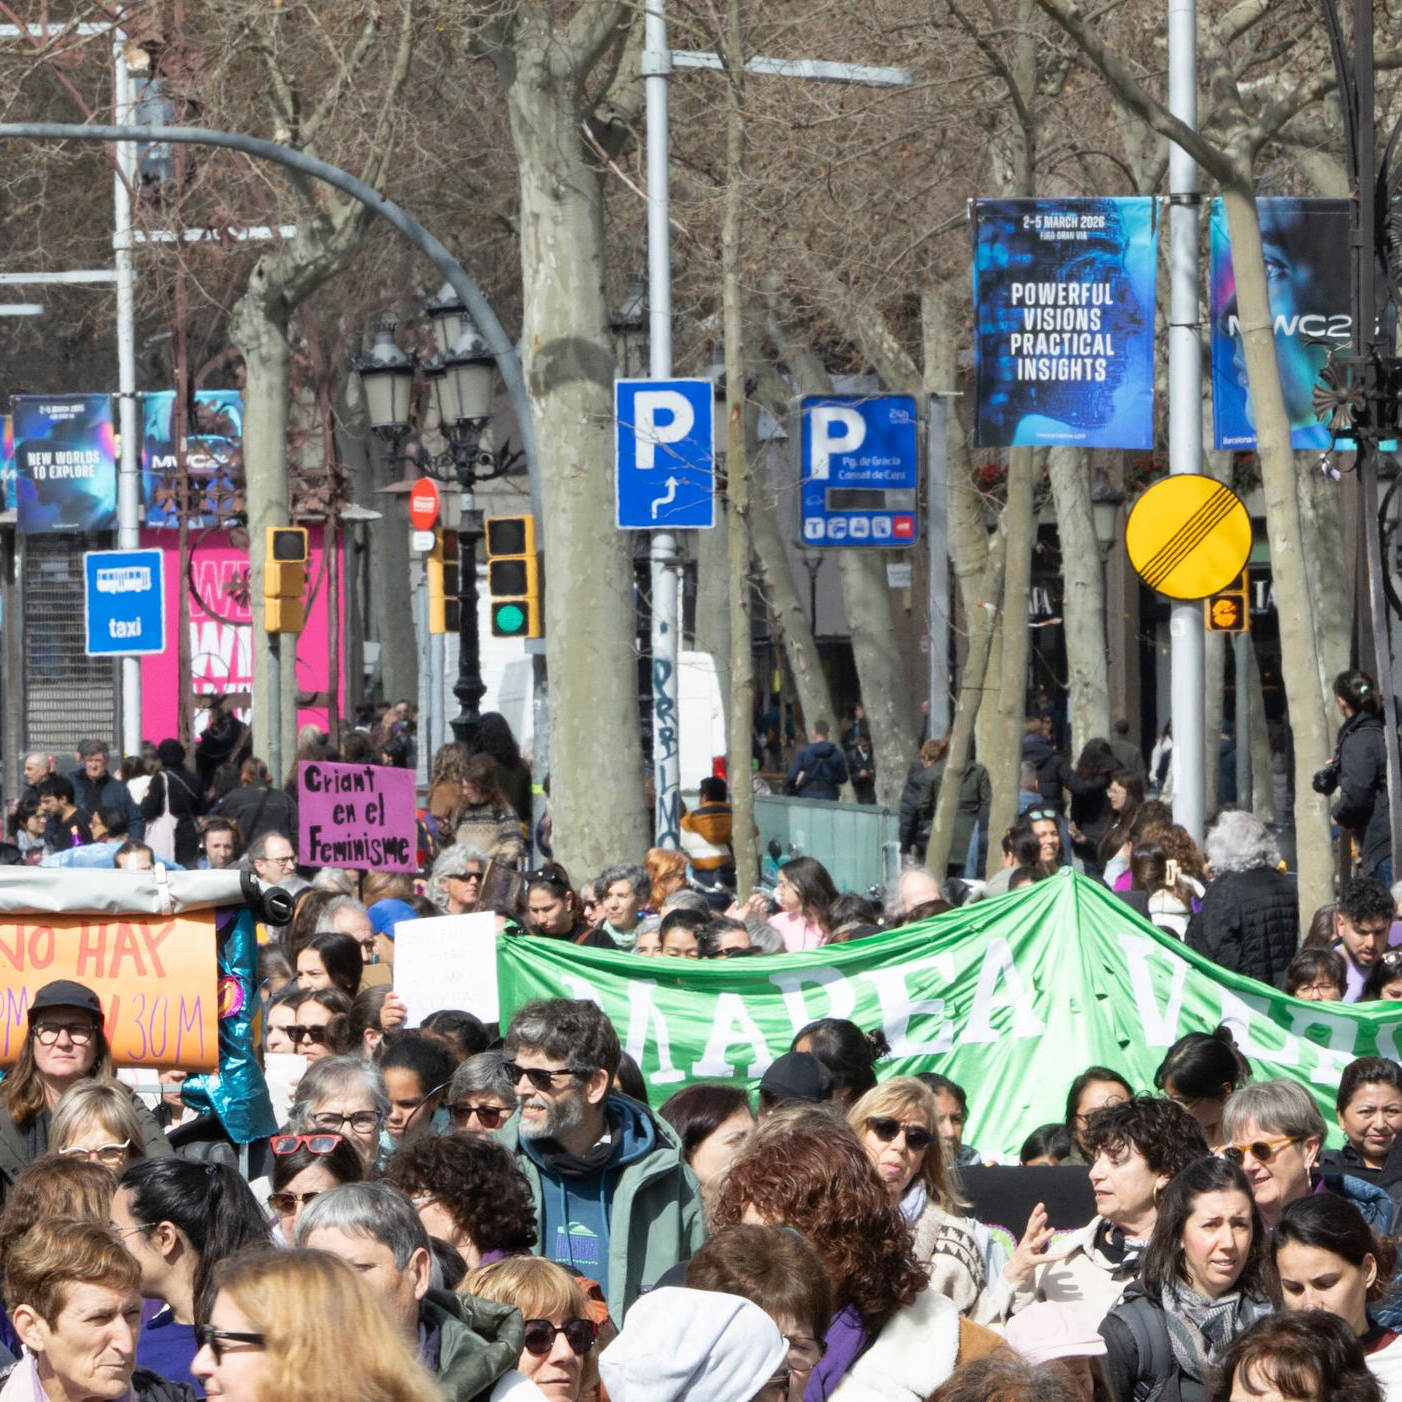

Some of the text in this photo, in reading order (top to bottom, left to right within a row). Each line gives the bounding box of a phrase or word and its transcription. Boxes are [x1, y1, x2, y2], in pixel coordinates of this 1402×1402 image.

[1023, 216, 1105, 229] 2-5 MARCH 2026
[1040, 230, 1088, 240] FIRA GRAN VIA
[1012, 282, 1113, 306] POWERFUL
[1024, 308, 1102, 331] VISIONS
[1010, 333, 1115, 356] PRACTICAL
[1018, 358, 1106, 382] INSIGHTS
[634, 390, 694, 470] P
[810, 406, 866, 480] P
[27, 450, 100, 466] NEW WORLDS
[860, 456, 871, 466] de
[34, 464, 96, 480] TO EXPLORE
[108, 616, 142, 638] taxi
[304, 765, 375, 794] Criant
[333, 792, 384, 826] en el
[309, 825, 410, 866] Feminisme
[77, 919, 178, 980] HAY
[128, 993, 204, 1064] 30M
